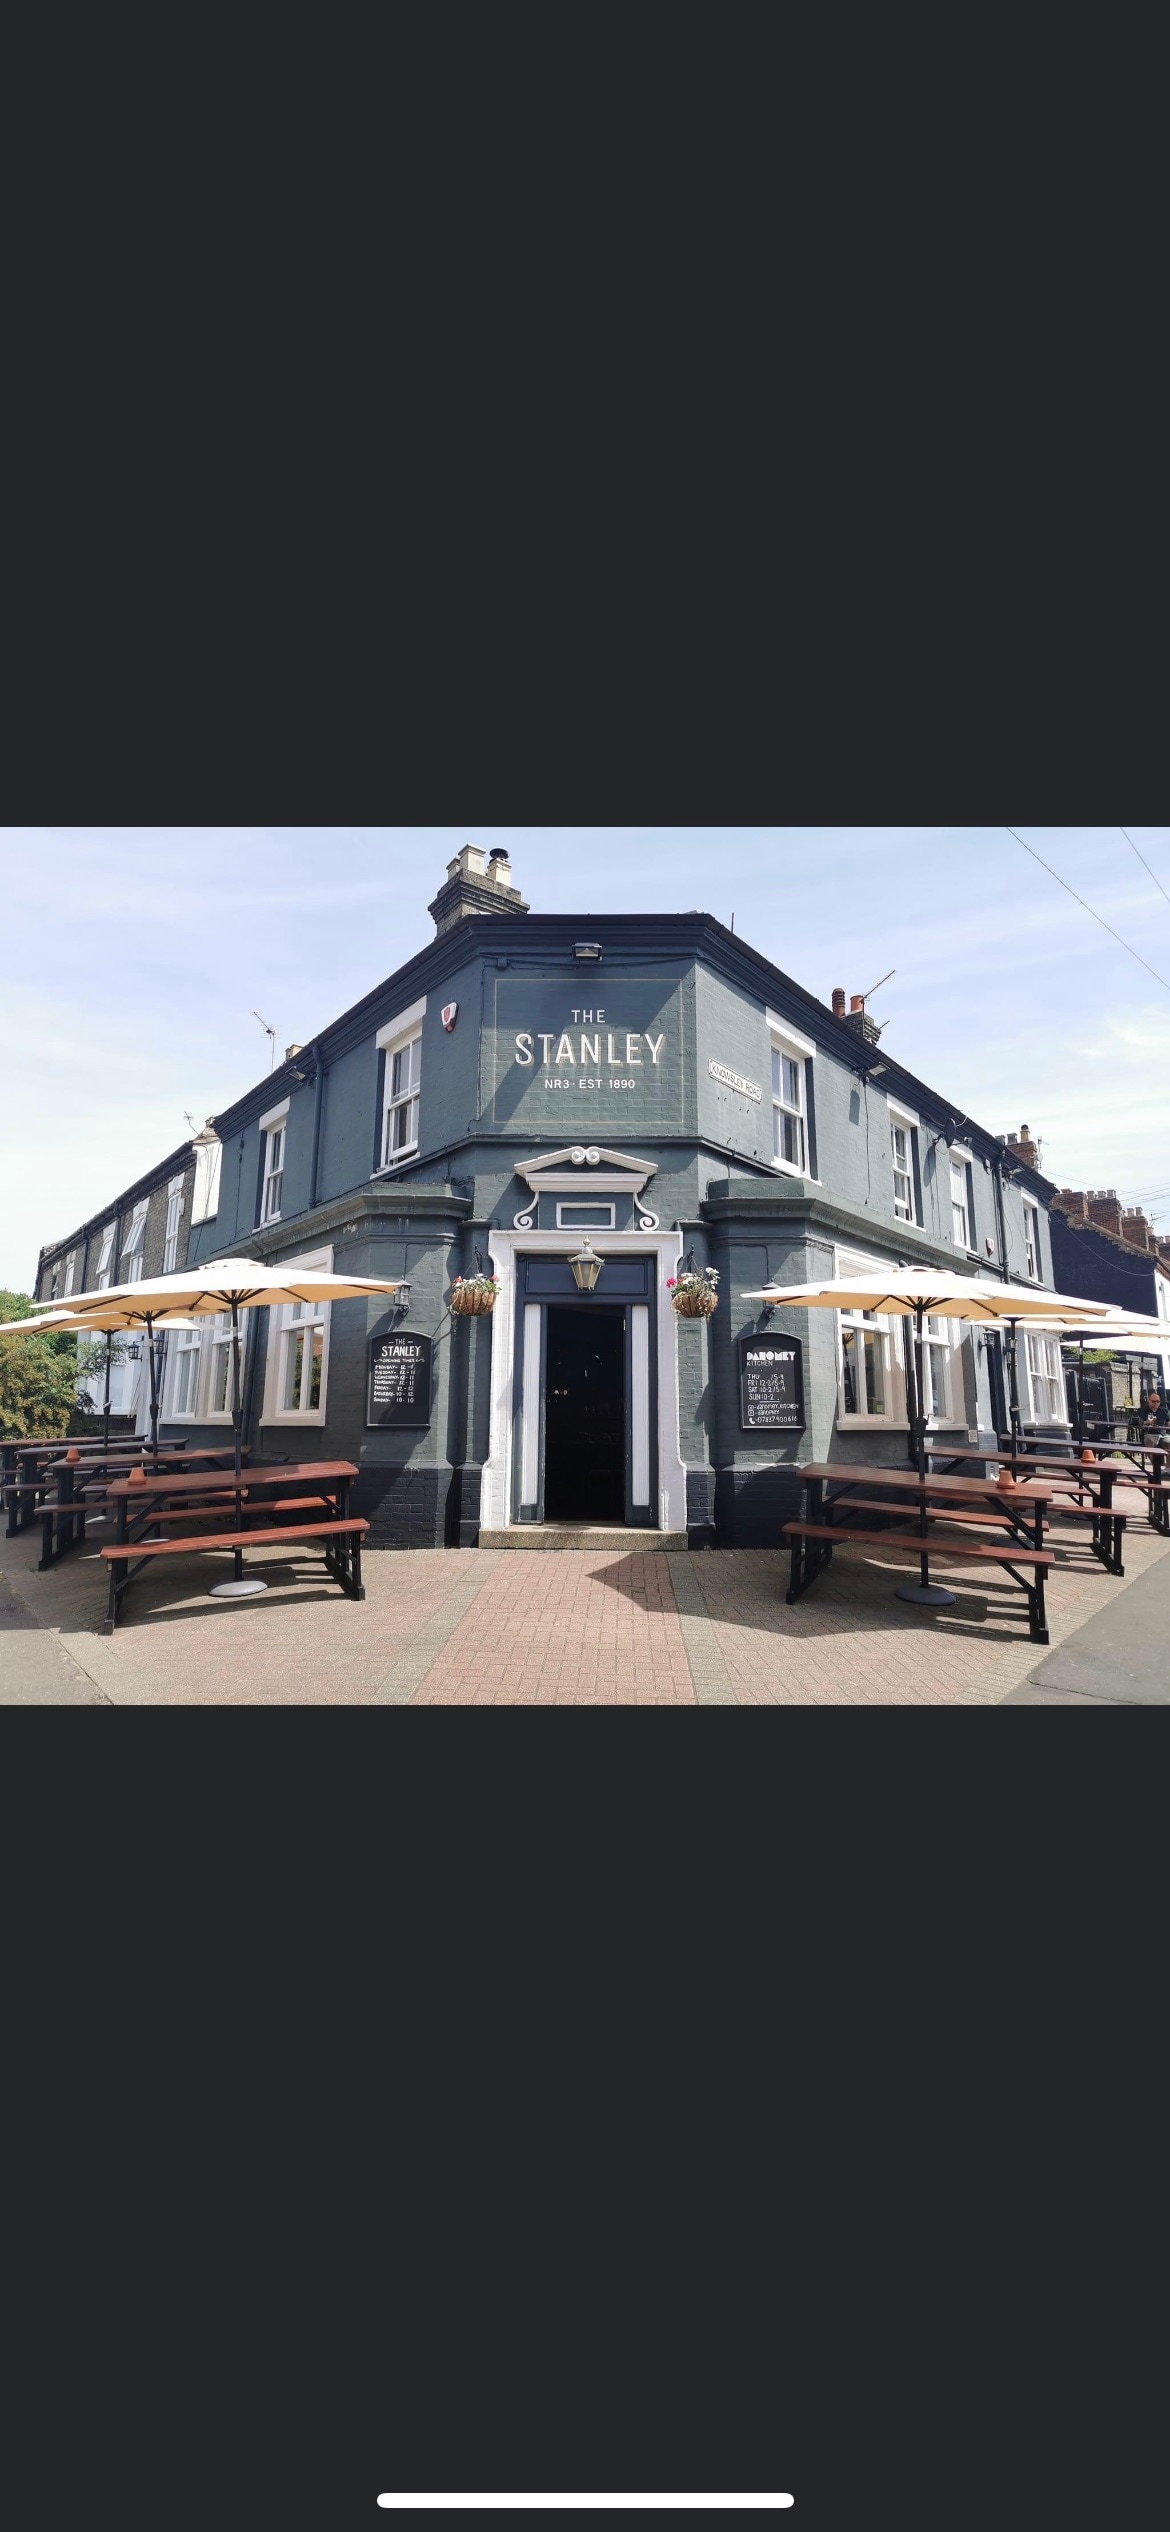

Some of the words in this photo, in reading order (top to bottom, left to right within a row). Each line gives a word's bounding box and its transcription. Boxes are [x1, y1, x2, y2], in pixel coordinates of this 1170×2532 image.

[571, 1009, 606, 1023] THE
[515, 1033, 665, 1065] STANLEY
[579, 1079, 603, 1089] EST
[609, 1079, 636, 1089] 1890
[711, 1062, 744, 1089] KNOWSLEY
[745, 1082, 761, 1099] ROAD
[382, 1346, 421, 1356] STANLEY
[747, 1351, 796, 1360] DAHOMEY
